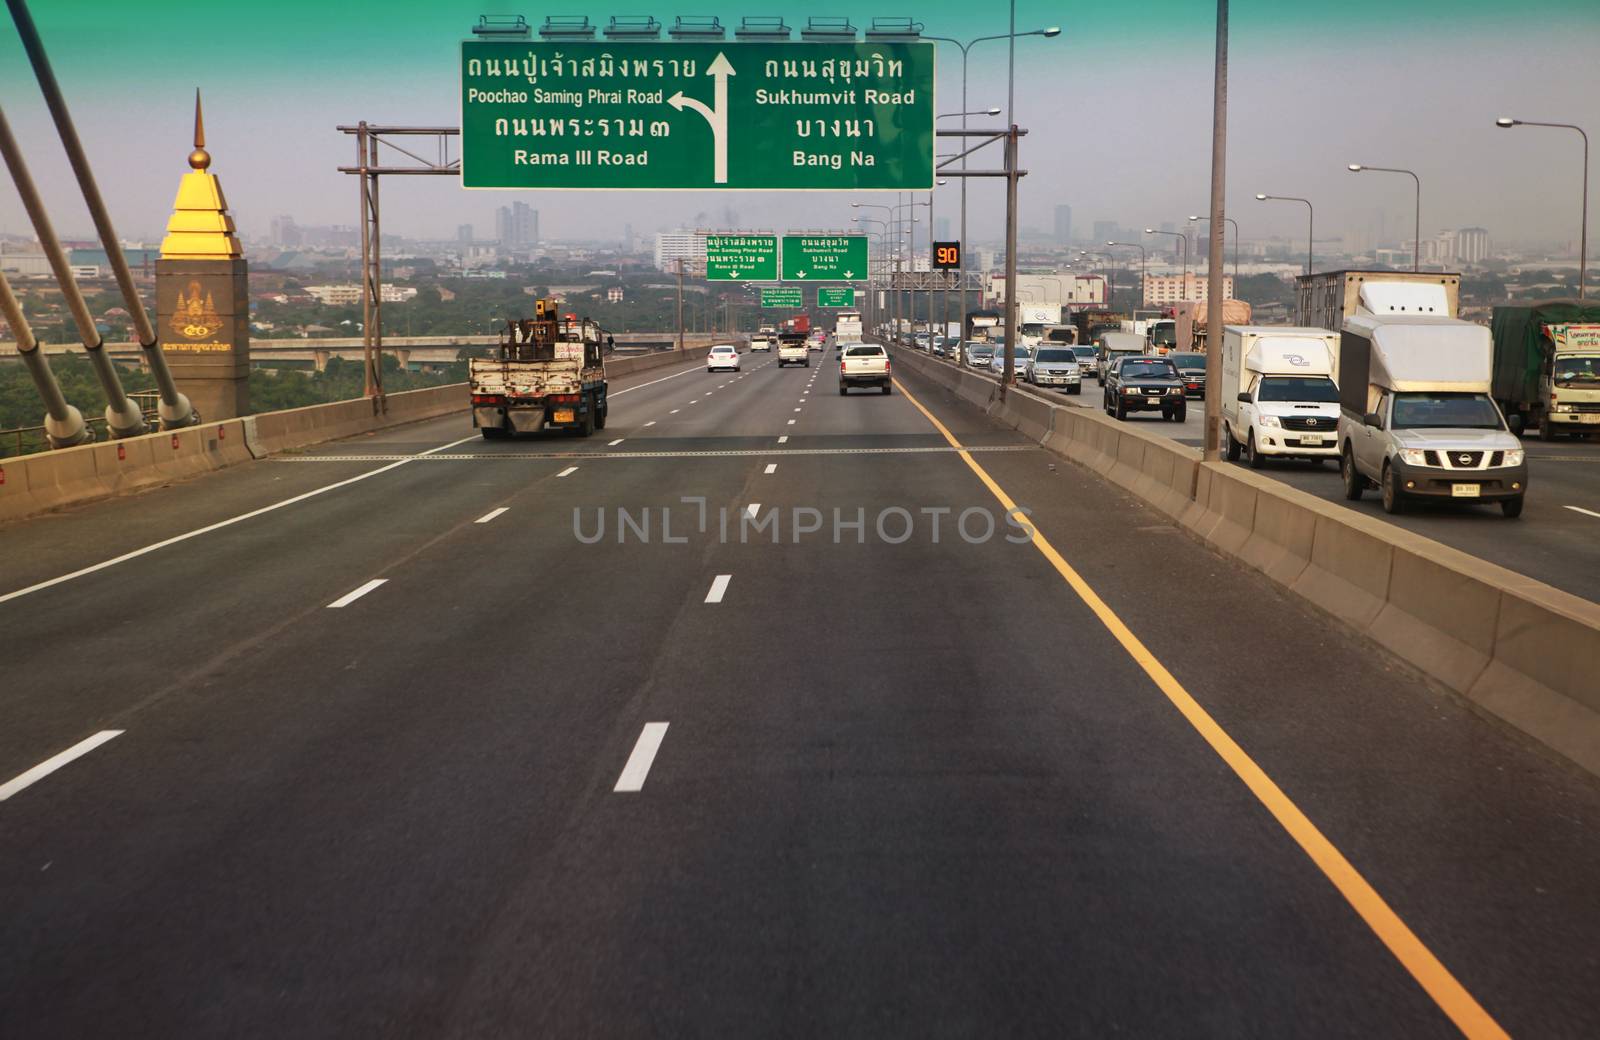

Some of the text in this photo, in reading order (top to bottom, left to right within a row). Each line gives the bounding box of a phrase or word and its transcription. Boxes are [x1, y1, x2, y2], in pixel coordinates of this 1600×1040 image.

[468, 51, 697, 85] ถนนปู่เจ้าสมิงพราย
[765, 52, 903, 84] ถนนสุขุมวิท
[468, 88, 663, 108] Poochao Saming Phrai Road
[756, 88, 915, 105] Sukhumvit Road
[796, 119, 875, 138] บางนา
[514, 149, 648, 166] Rama III Road
[793, 150, 875, 170] Bang Na
[812, 255, 839, 263] บางนา
[937, 247, 957, 264] 90
